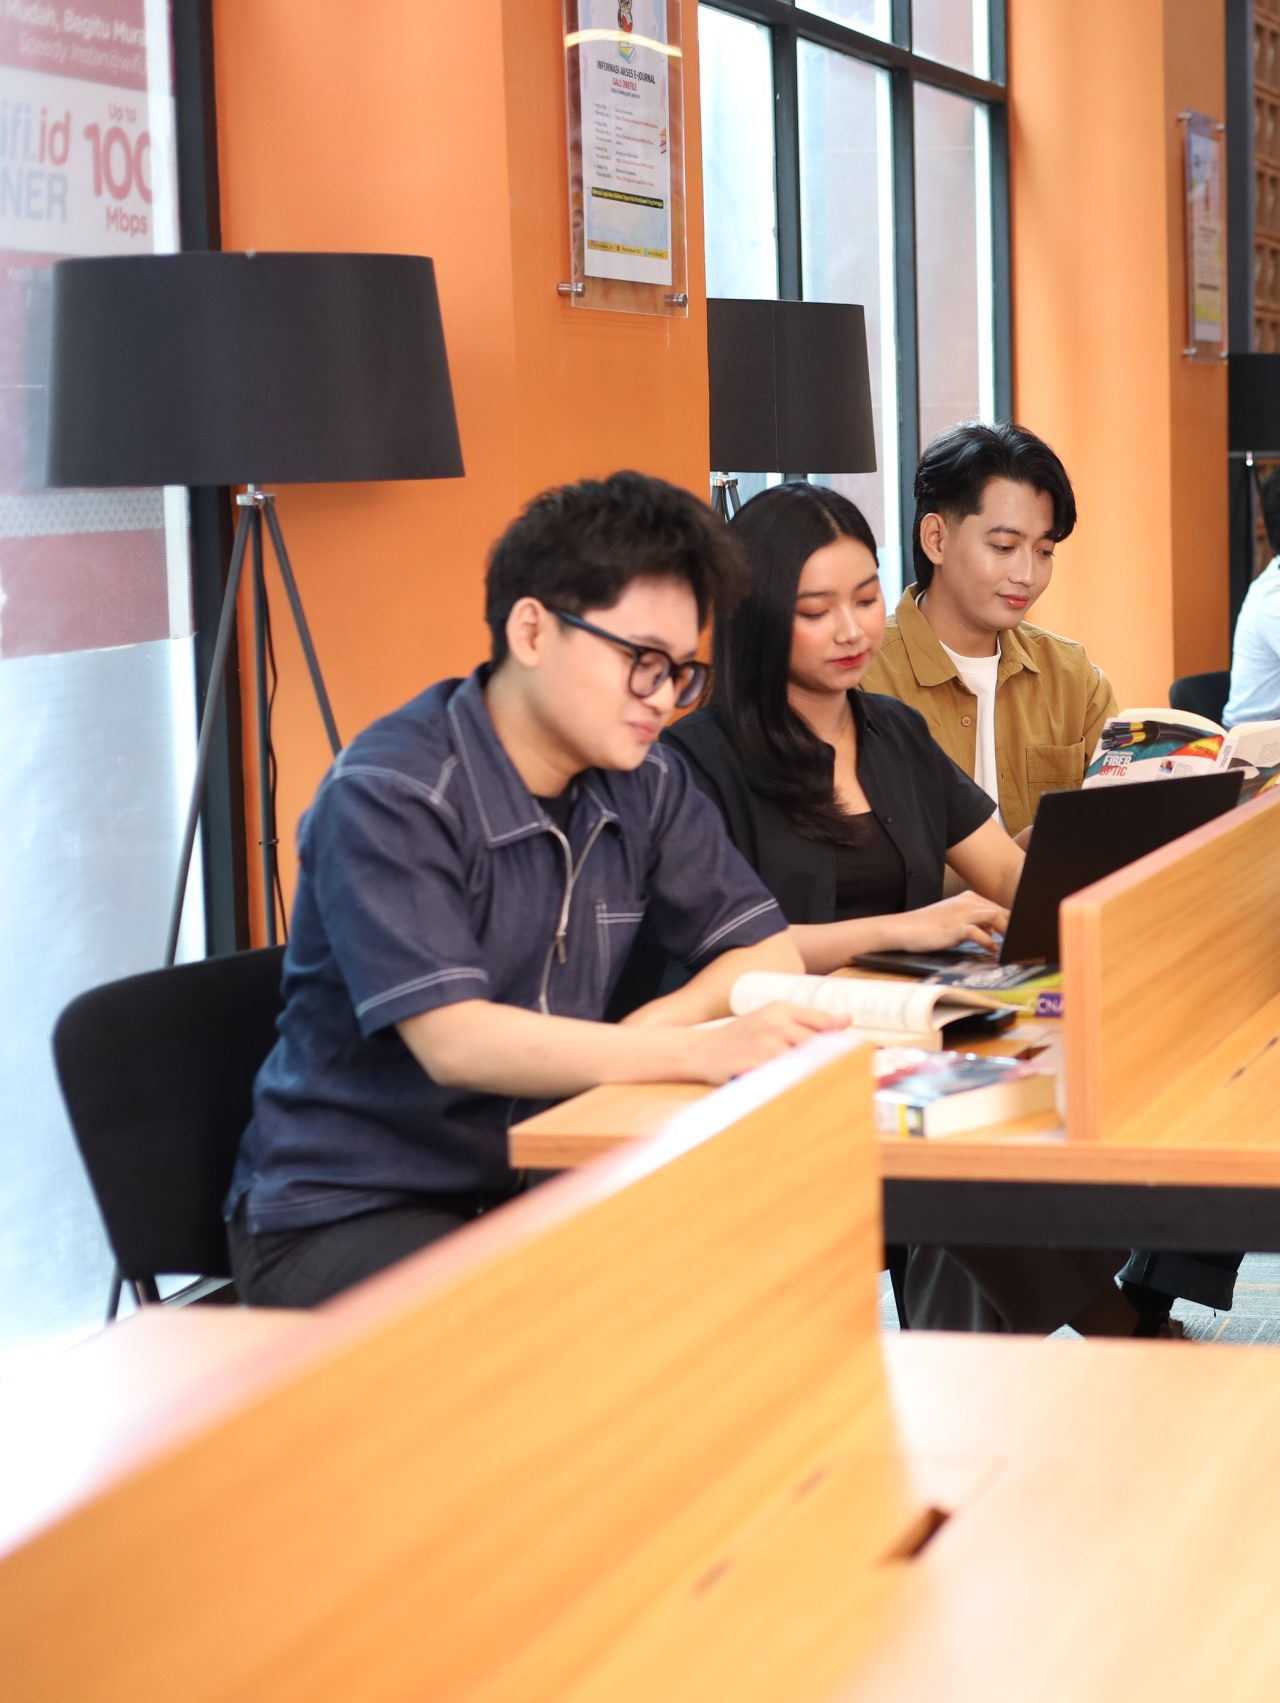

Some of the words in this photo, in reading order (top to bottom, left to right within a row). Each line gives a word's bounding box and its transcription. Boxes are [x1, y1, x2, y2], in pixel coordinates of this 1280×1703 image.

[64, 8, 110, 39] Begitu
[113, 20, 146, 46] Mura
[107, 102, 124, 124] Up
[126, 105, 137, 122] to
[0, 100, 72, 166] ifi.id
[0, 165, 68, 222] NER
[106, 207, 148, 238] Mbps
[1100, 766, 1127, 776] OPTIC
[1103, 755, 1132, 766] FIBER
